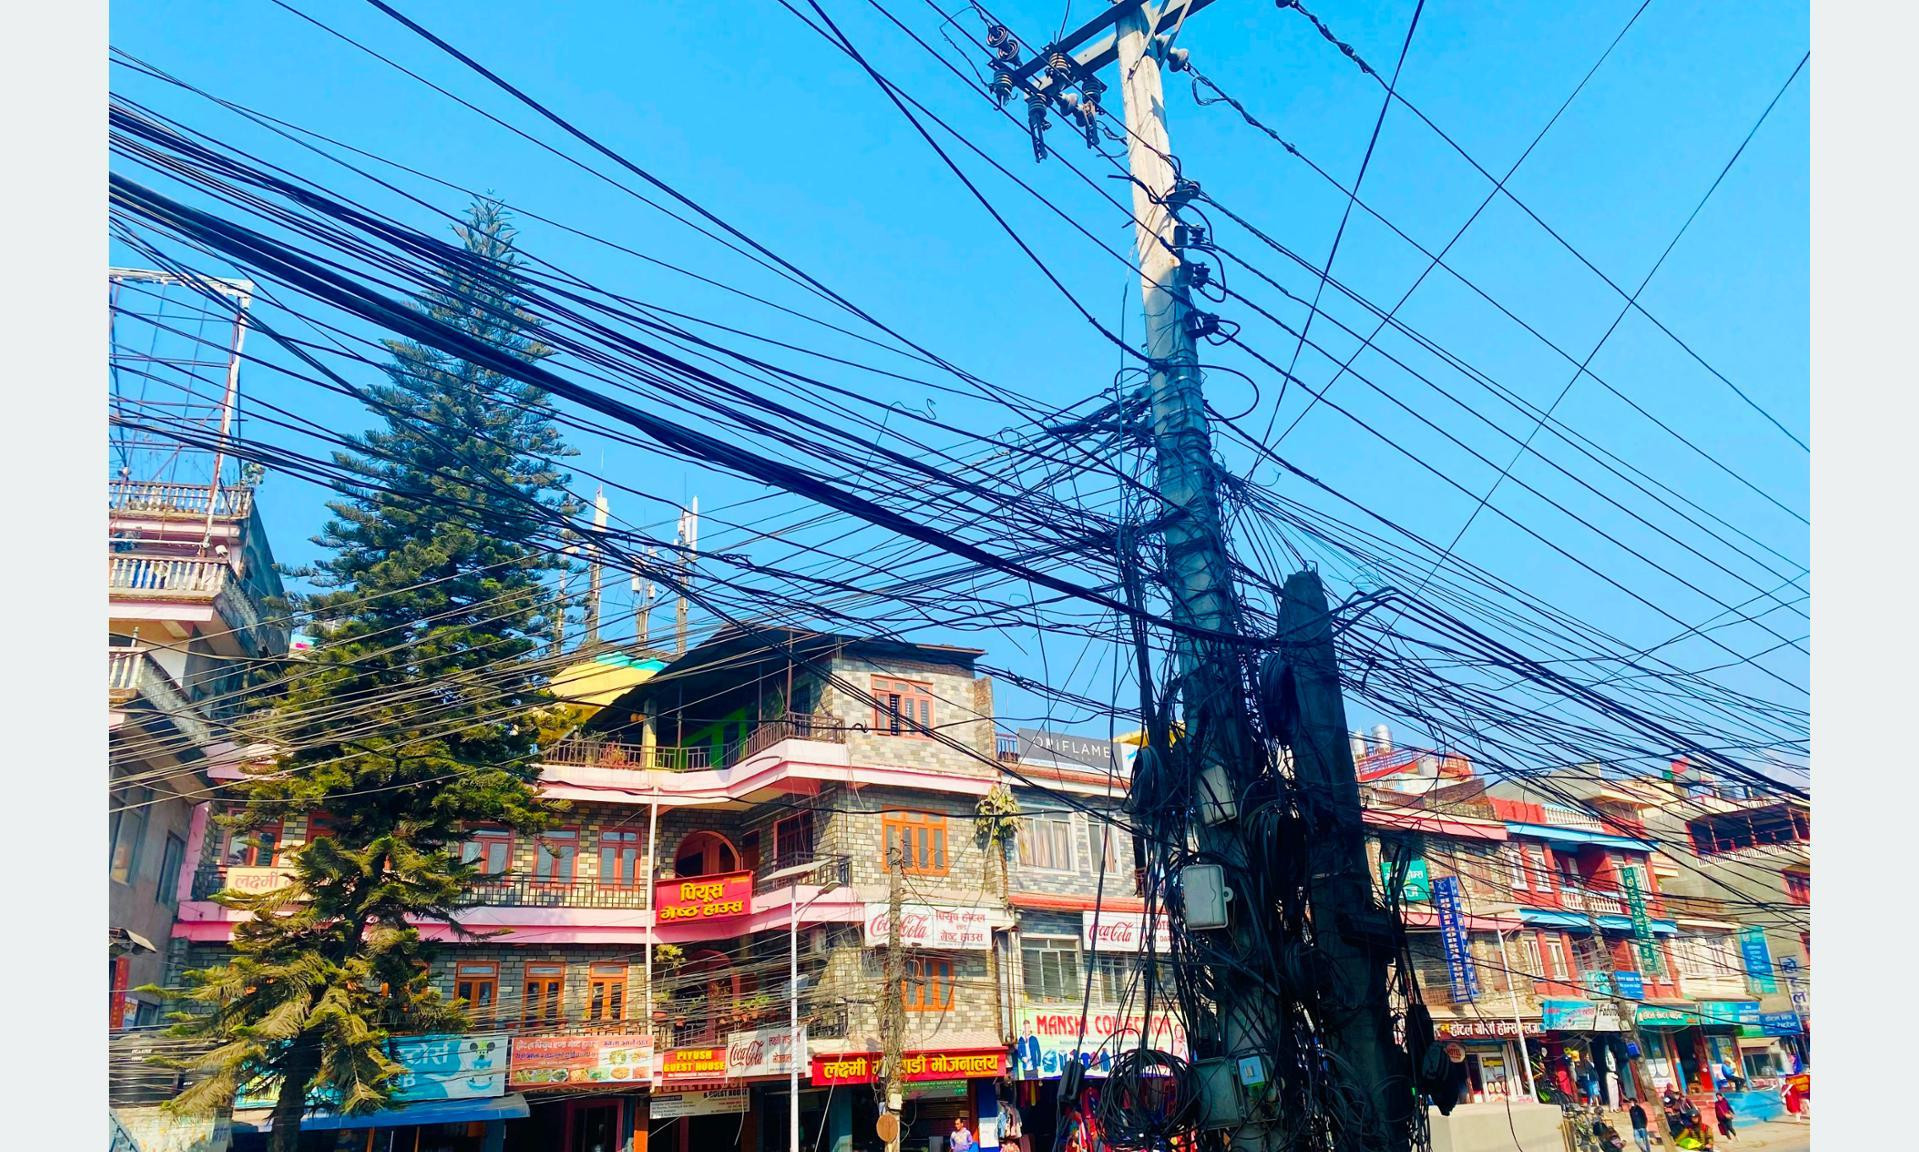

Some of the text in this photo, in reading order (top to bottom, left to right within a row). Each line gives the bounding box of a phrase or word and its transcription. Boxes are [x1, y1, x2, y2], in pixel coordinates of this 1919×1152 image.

[1033, 737, 1111, 758] ORIFLAME
[677, 1050, 712, 1060] PIYUSH
[663, 1061, 725, 1072] GUEST HOUSE
[932, 1054, 998, 1073] भोजनालय
